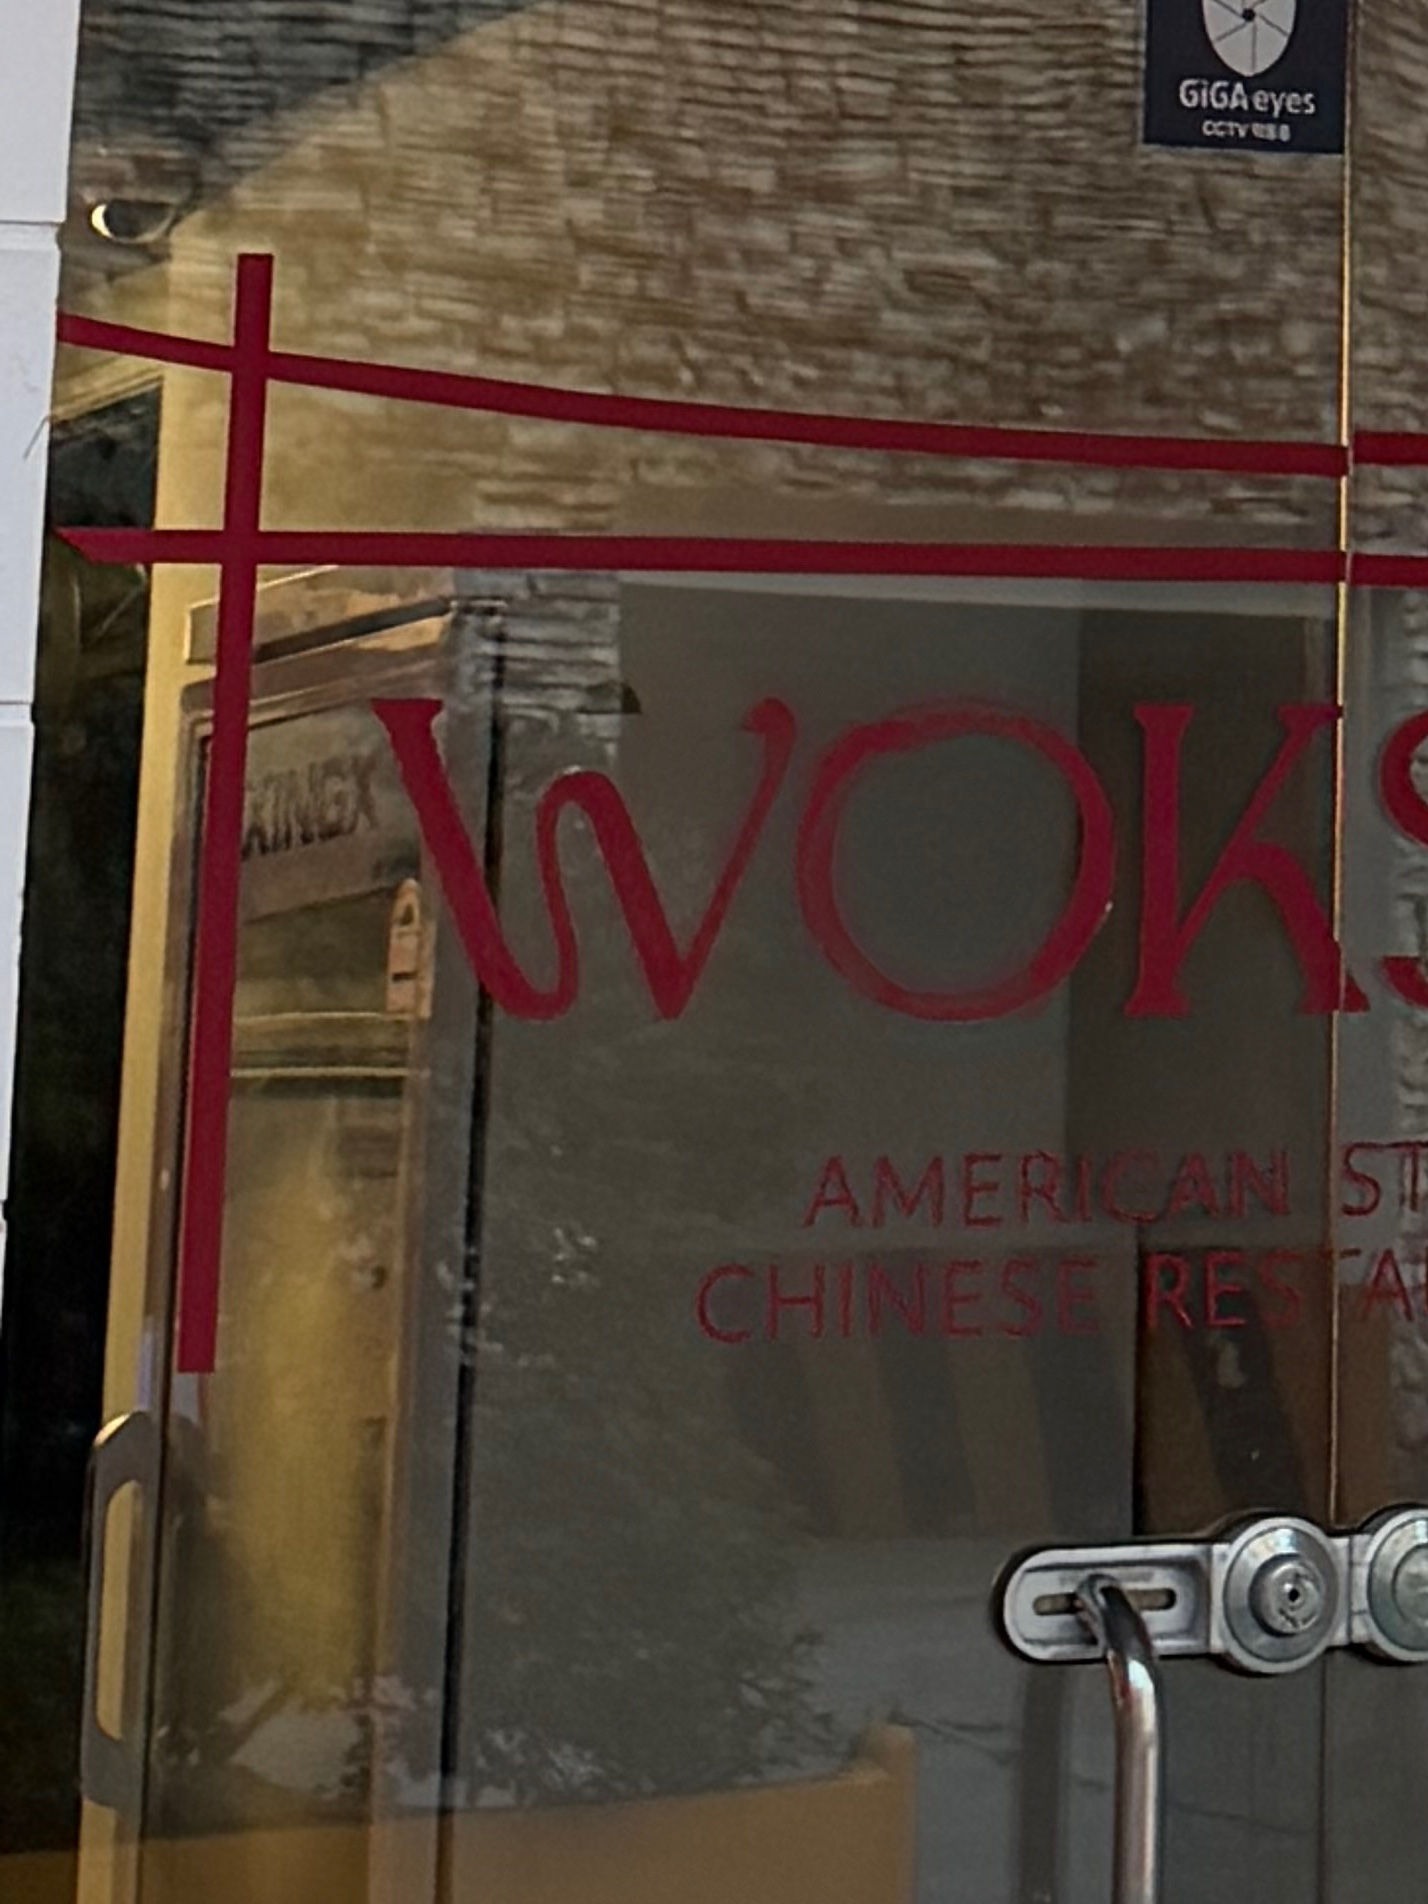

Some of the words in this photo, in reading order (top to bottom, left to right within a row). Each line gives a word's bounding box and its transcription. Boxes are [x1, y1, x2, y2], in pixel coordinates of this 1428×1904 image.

[1201, 119, 1250, 139] CCTV
[802, 1147, 1291, 1229] AMERICAN
[694, 1258, 1099, 1344] CHINESE
